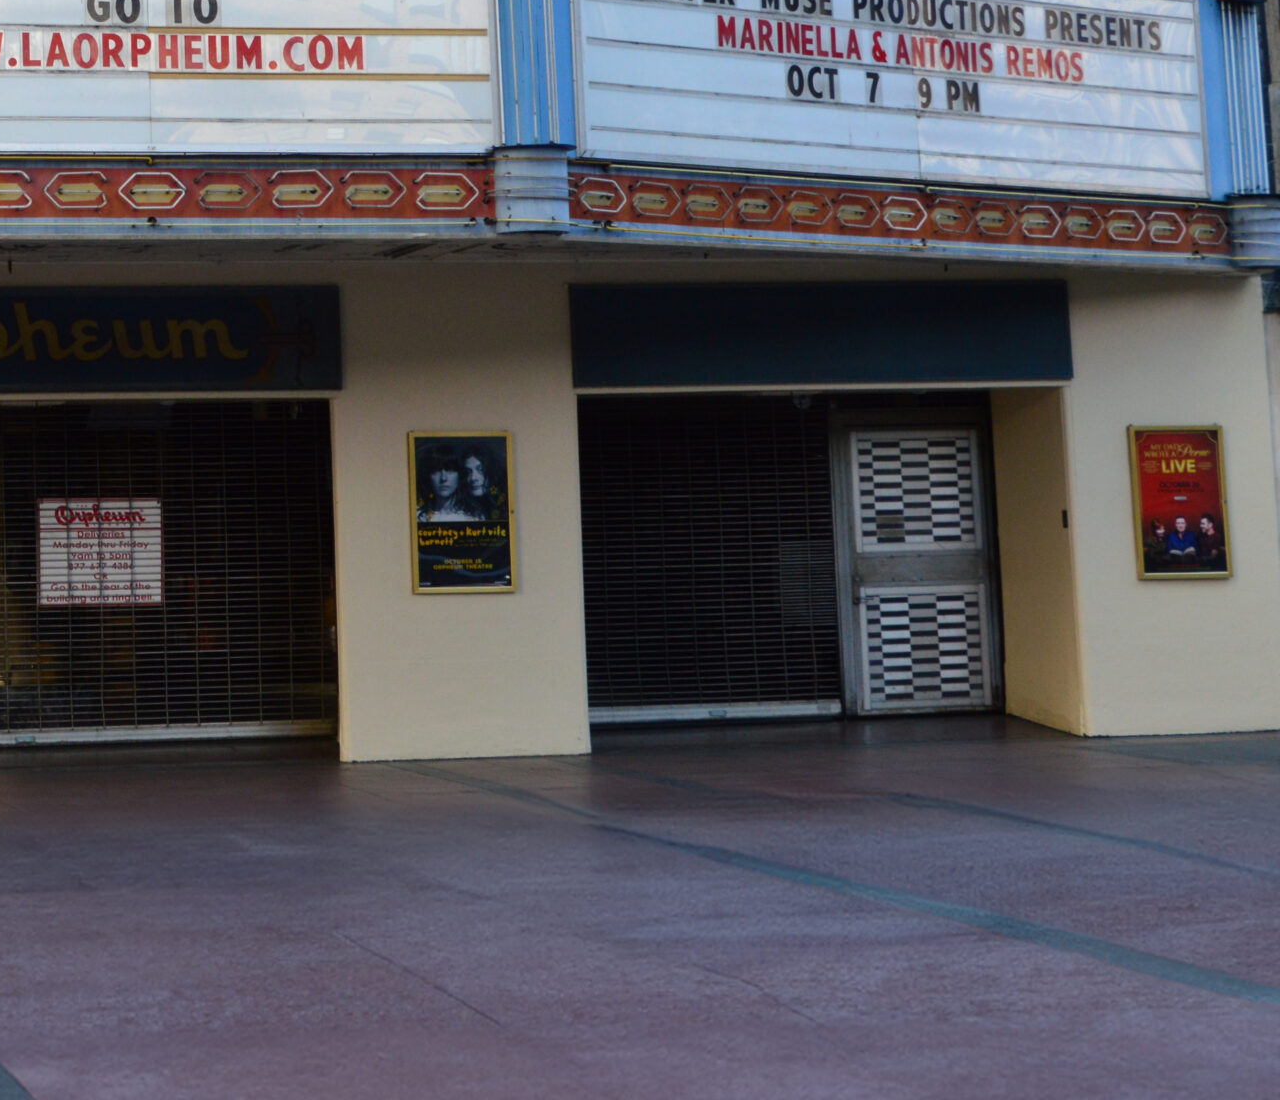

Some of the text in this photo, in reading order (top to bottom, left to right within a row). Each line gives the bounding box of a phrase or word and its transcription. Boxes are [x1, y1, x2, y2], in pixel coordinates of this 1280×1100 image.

[1045, 12, 1161, 50] PRESENTS
[717, 16, 1083, 82] MARINELLA & ANTONIS REMOS
[787, 65, 980, 113] OCT 7 9 PM
[1161, 459, 1197, 474] LIVE
[55, 504, 146, 527] Orpheum
[418, 527, 458, 540] courtney
